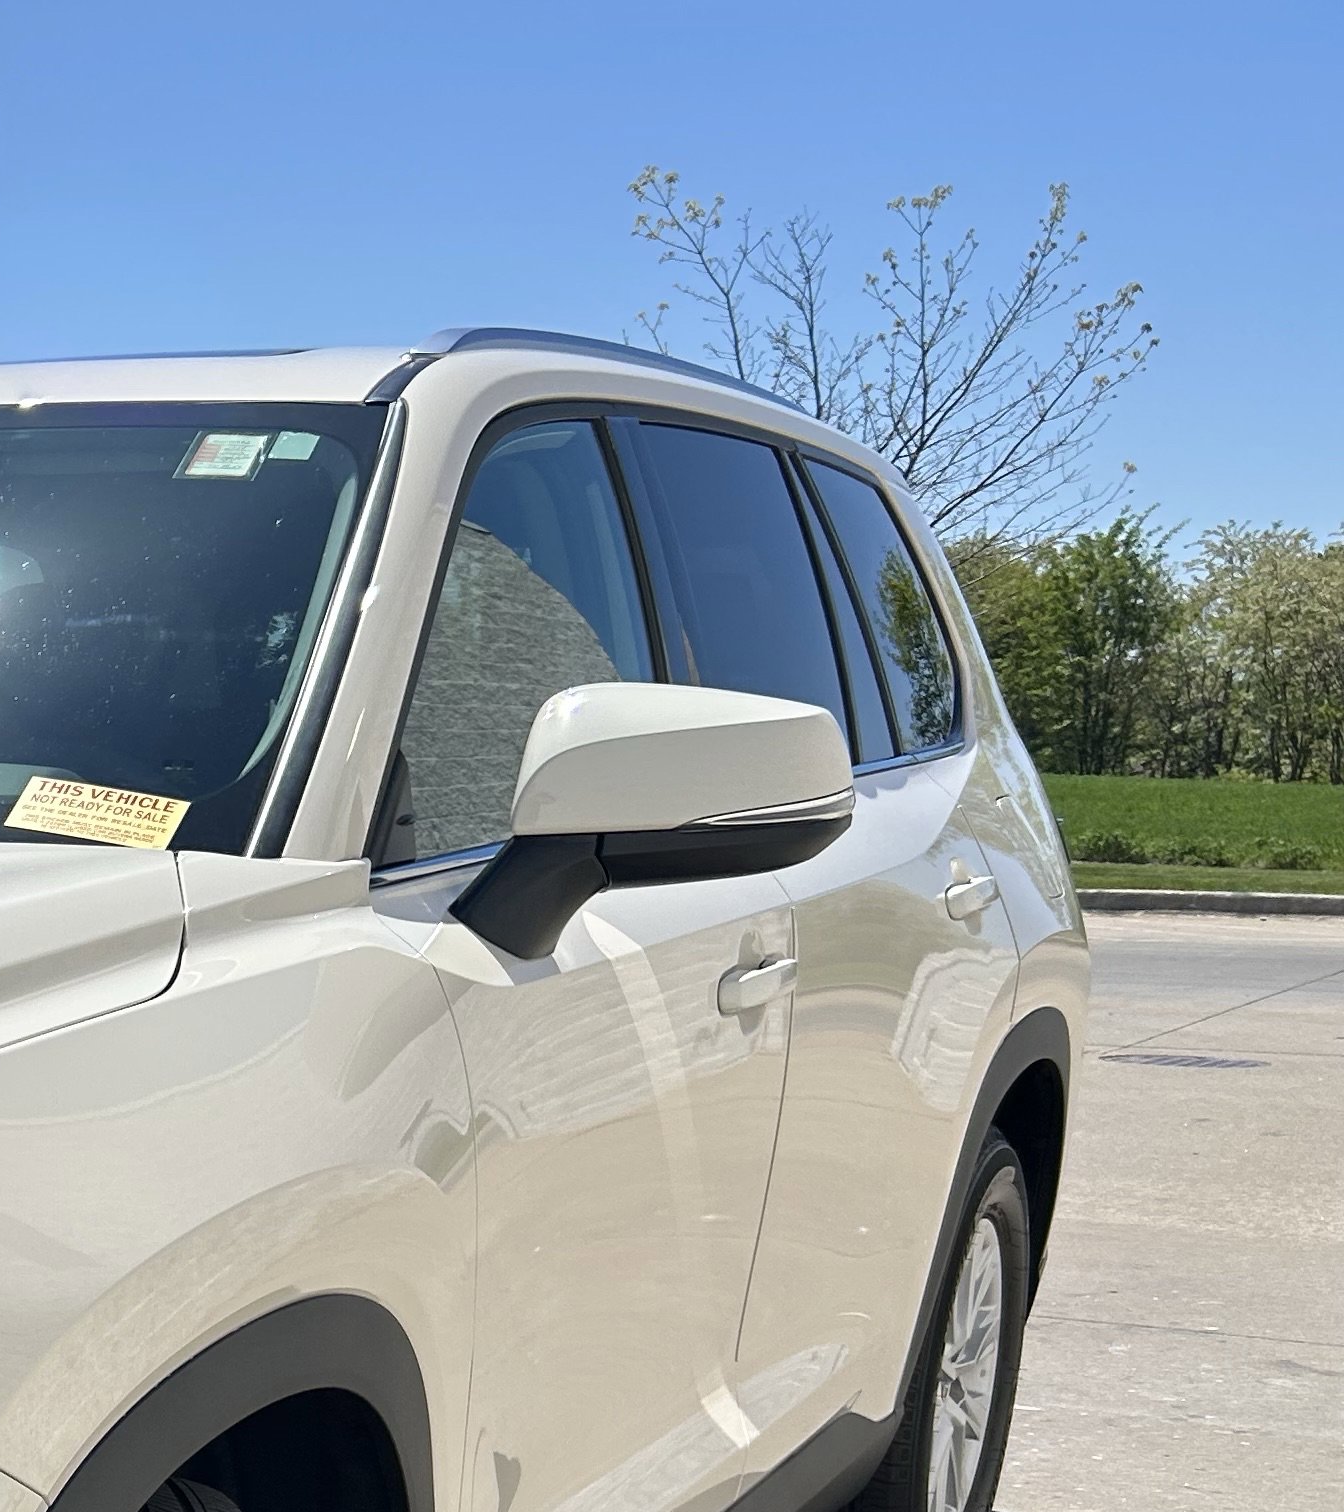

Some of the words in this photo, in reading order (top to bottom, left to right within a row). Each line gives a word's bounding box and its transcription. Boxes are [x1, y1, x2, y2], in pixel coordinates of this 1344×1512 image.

[30, 793, 59, 805] NOT
[59, 798, 104, 813] READY
[104, 805, 132, 819] FOR
[134, 810, 170, 825] SALE
[39, 780, 84, 797] THIS
[91, 788, 179, 814] VEHICLE
